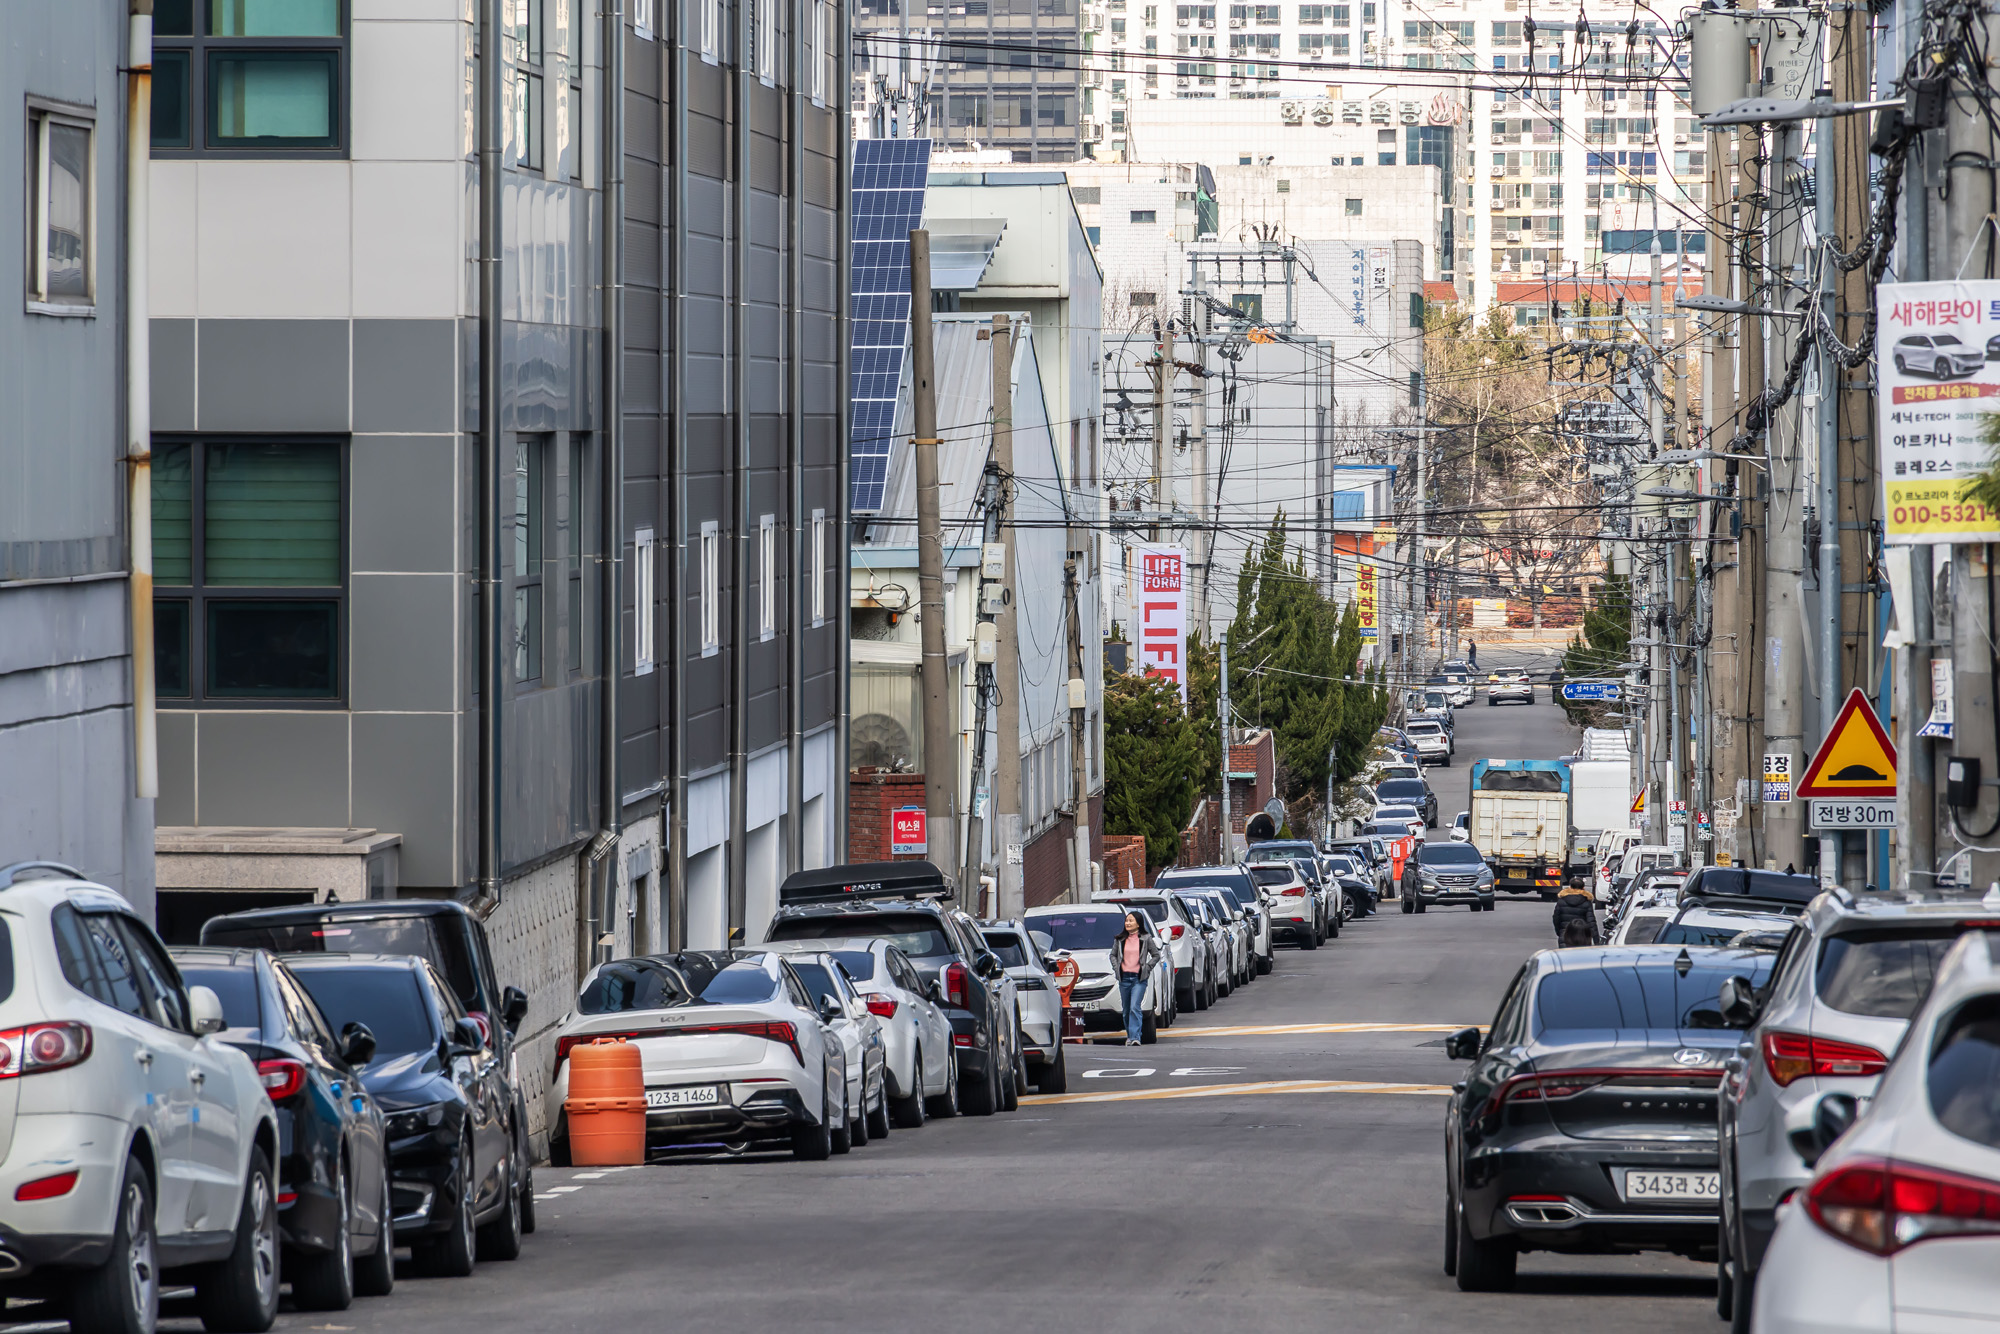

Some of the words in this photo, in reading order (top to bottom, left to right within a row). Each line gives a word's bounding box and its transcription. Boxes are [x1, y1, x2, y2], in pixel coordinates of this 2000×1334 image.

[1890, 299, 1981, 327] 새해맞이
[1891, 411, 1912, 424] 세닉
[1915, 413, 1951, 422] E-TECH
[1893, 433, 1952, 448] 아르카나
[1894, 460, 1952, 475] 콜레오스
[1905, 490, 1949, 501] 르노코리아
[1144, 558, 1180, 575] LIFE
[1145, 576, 1180, 589] FORM
[1764, 757, 1789, 773] 공장
[1669, 801, 1686, 811] 공장
[1818, 806, 1851, 822] 전방
[1854, 806, 1894, 822] 30m
[898, 820, 920, 832] 에스원
[648, 1093, 680, 1105] 123라
[684, 1089, 714, 1102] 1466
[1635, 1176, 1688, 1194] 343라
